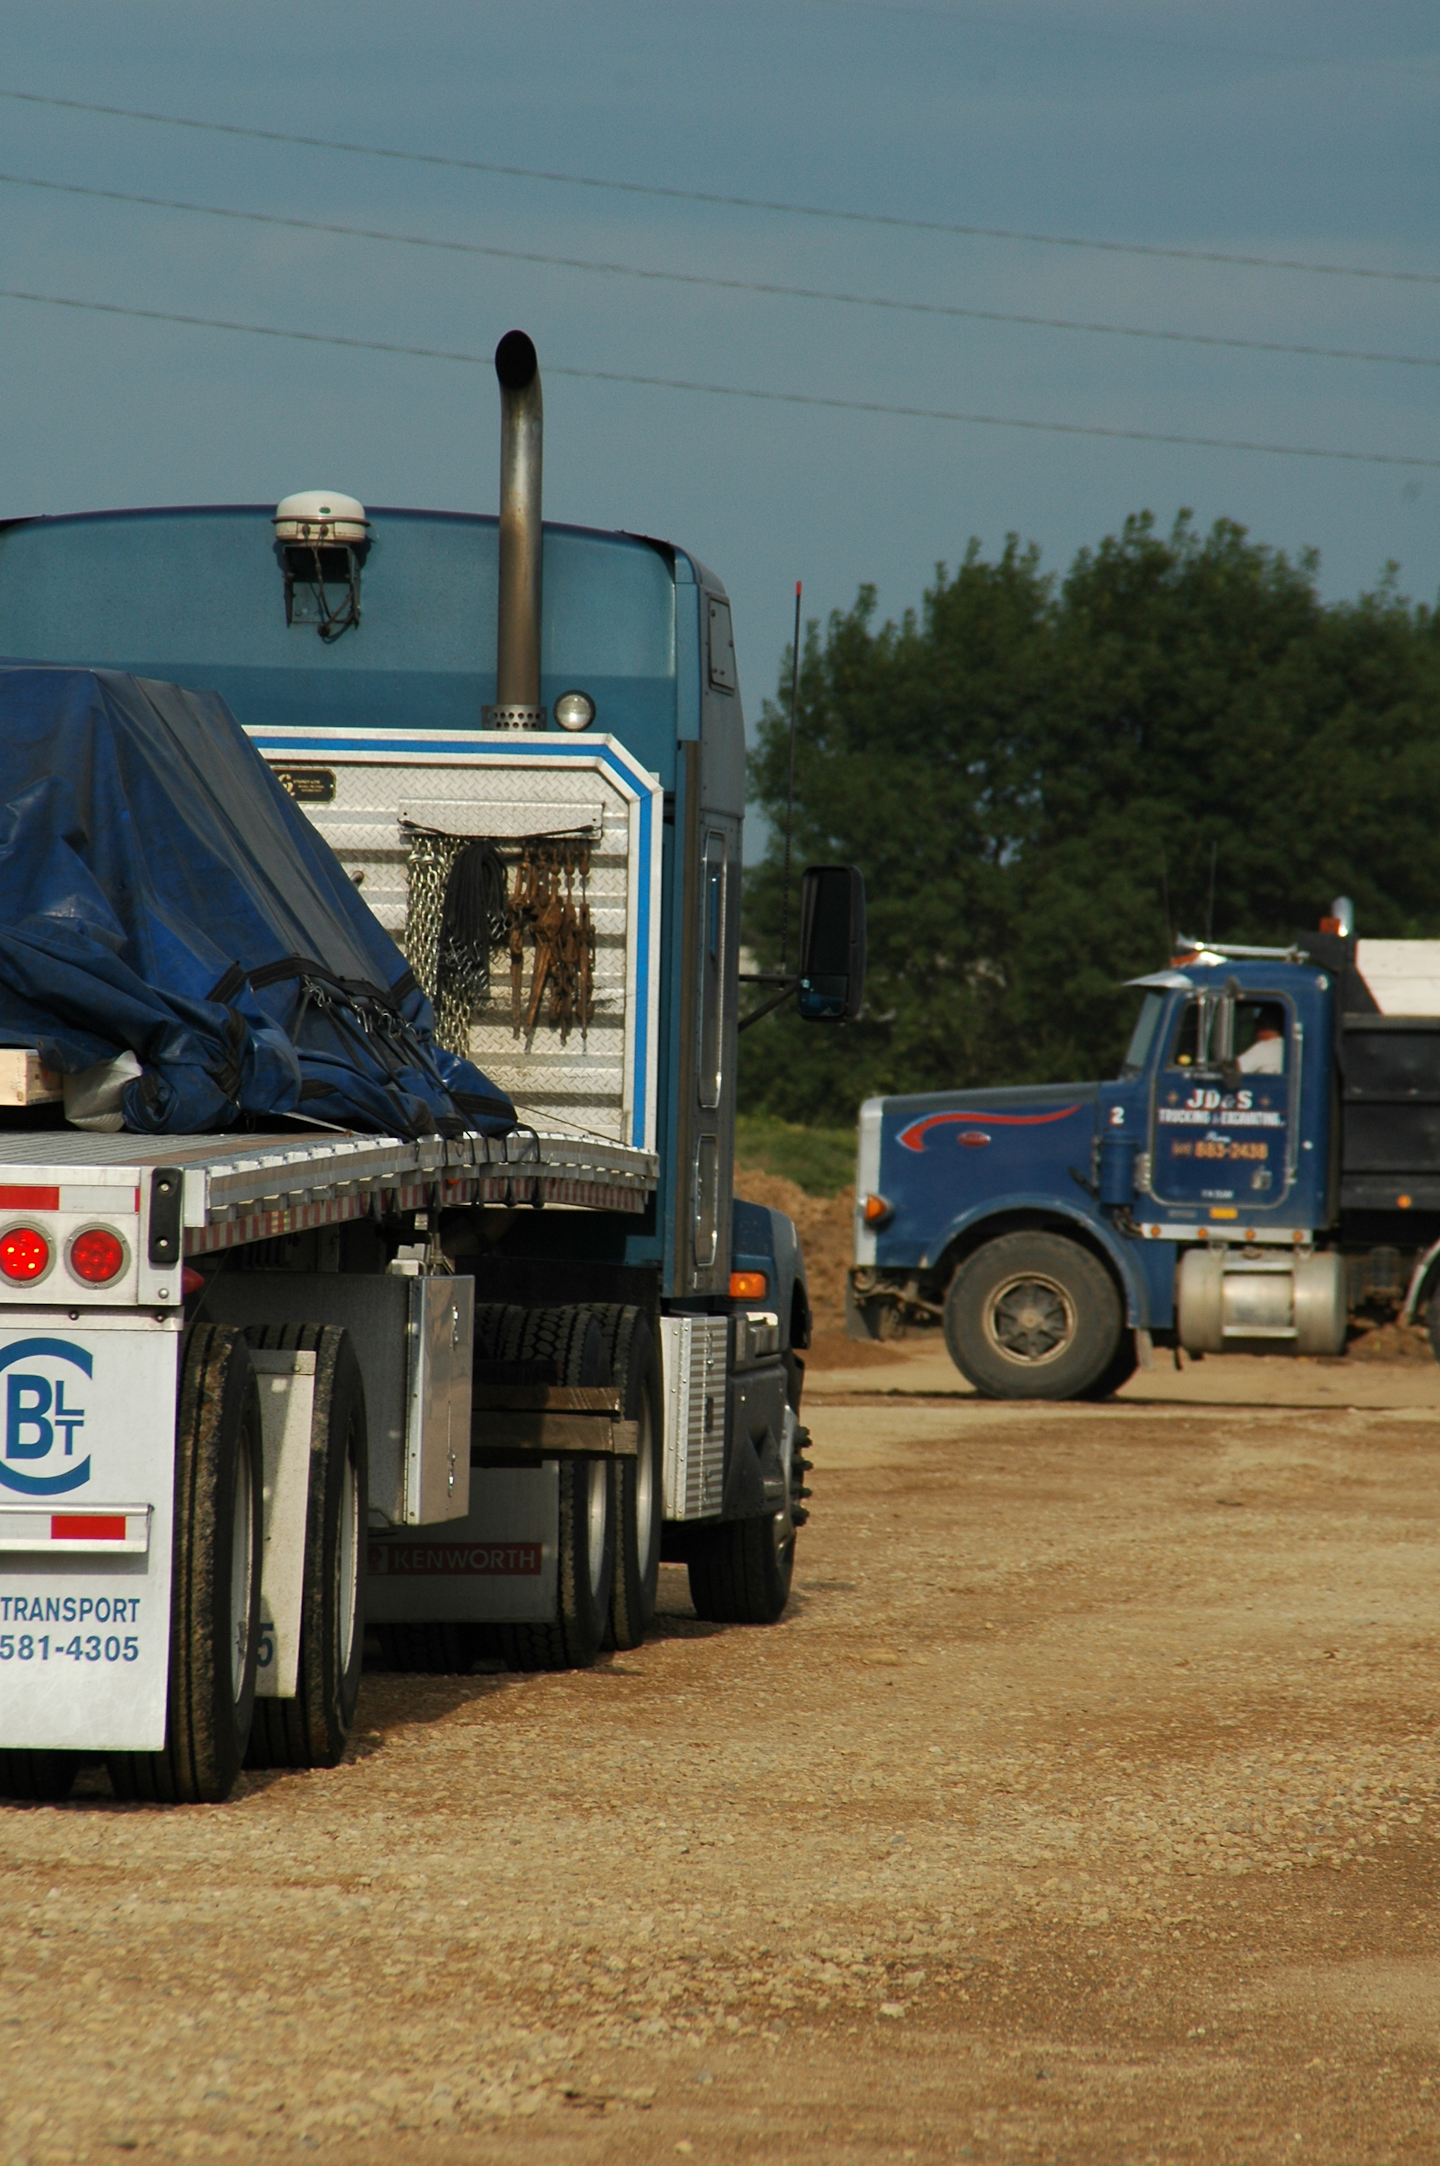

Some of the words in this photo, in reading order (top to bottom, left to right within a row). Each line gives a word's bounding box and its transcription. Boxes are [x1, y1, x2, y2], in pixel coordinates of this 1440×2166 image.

[1110, 1106, 1125, 1125] 2
[1158, 1109, 1211, 1124] TRUCKING
[394, 1550, 536, 1569] KENWORTH
[0, 1597, 140, 1623] TRANSPORT
[0, 1635, 139, 1662] 581-4305
